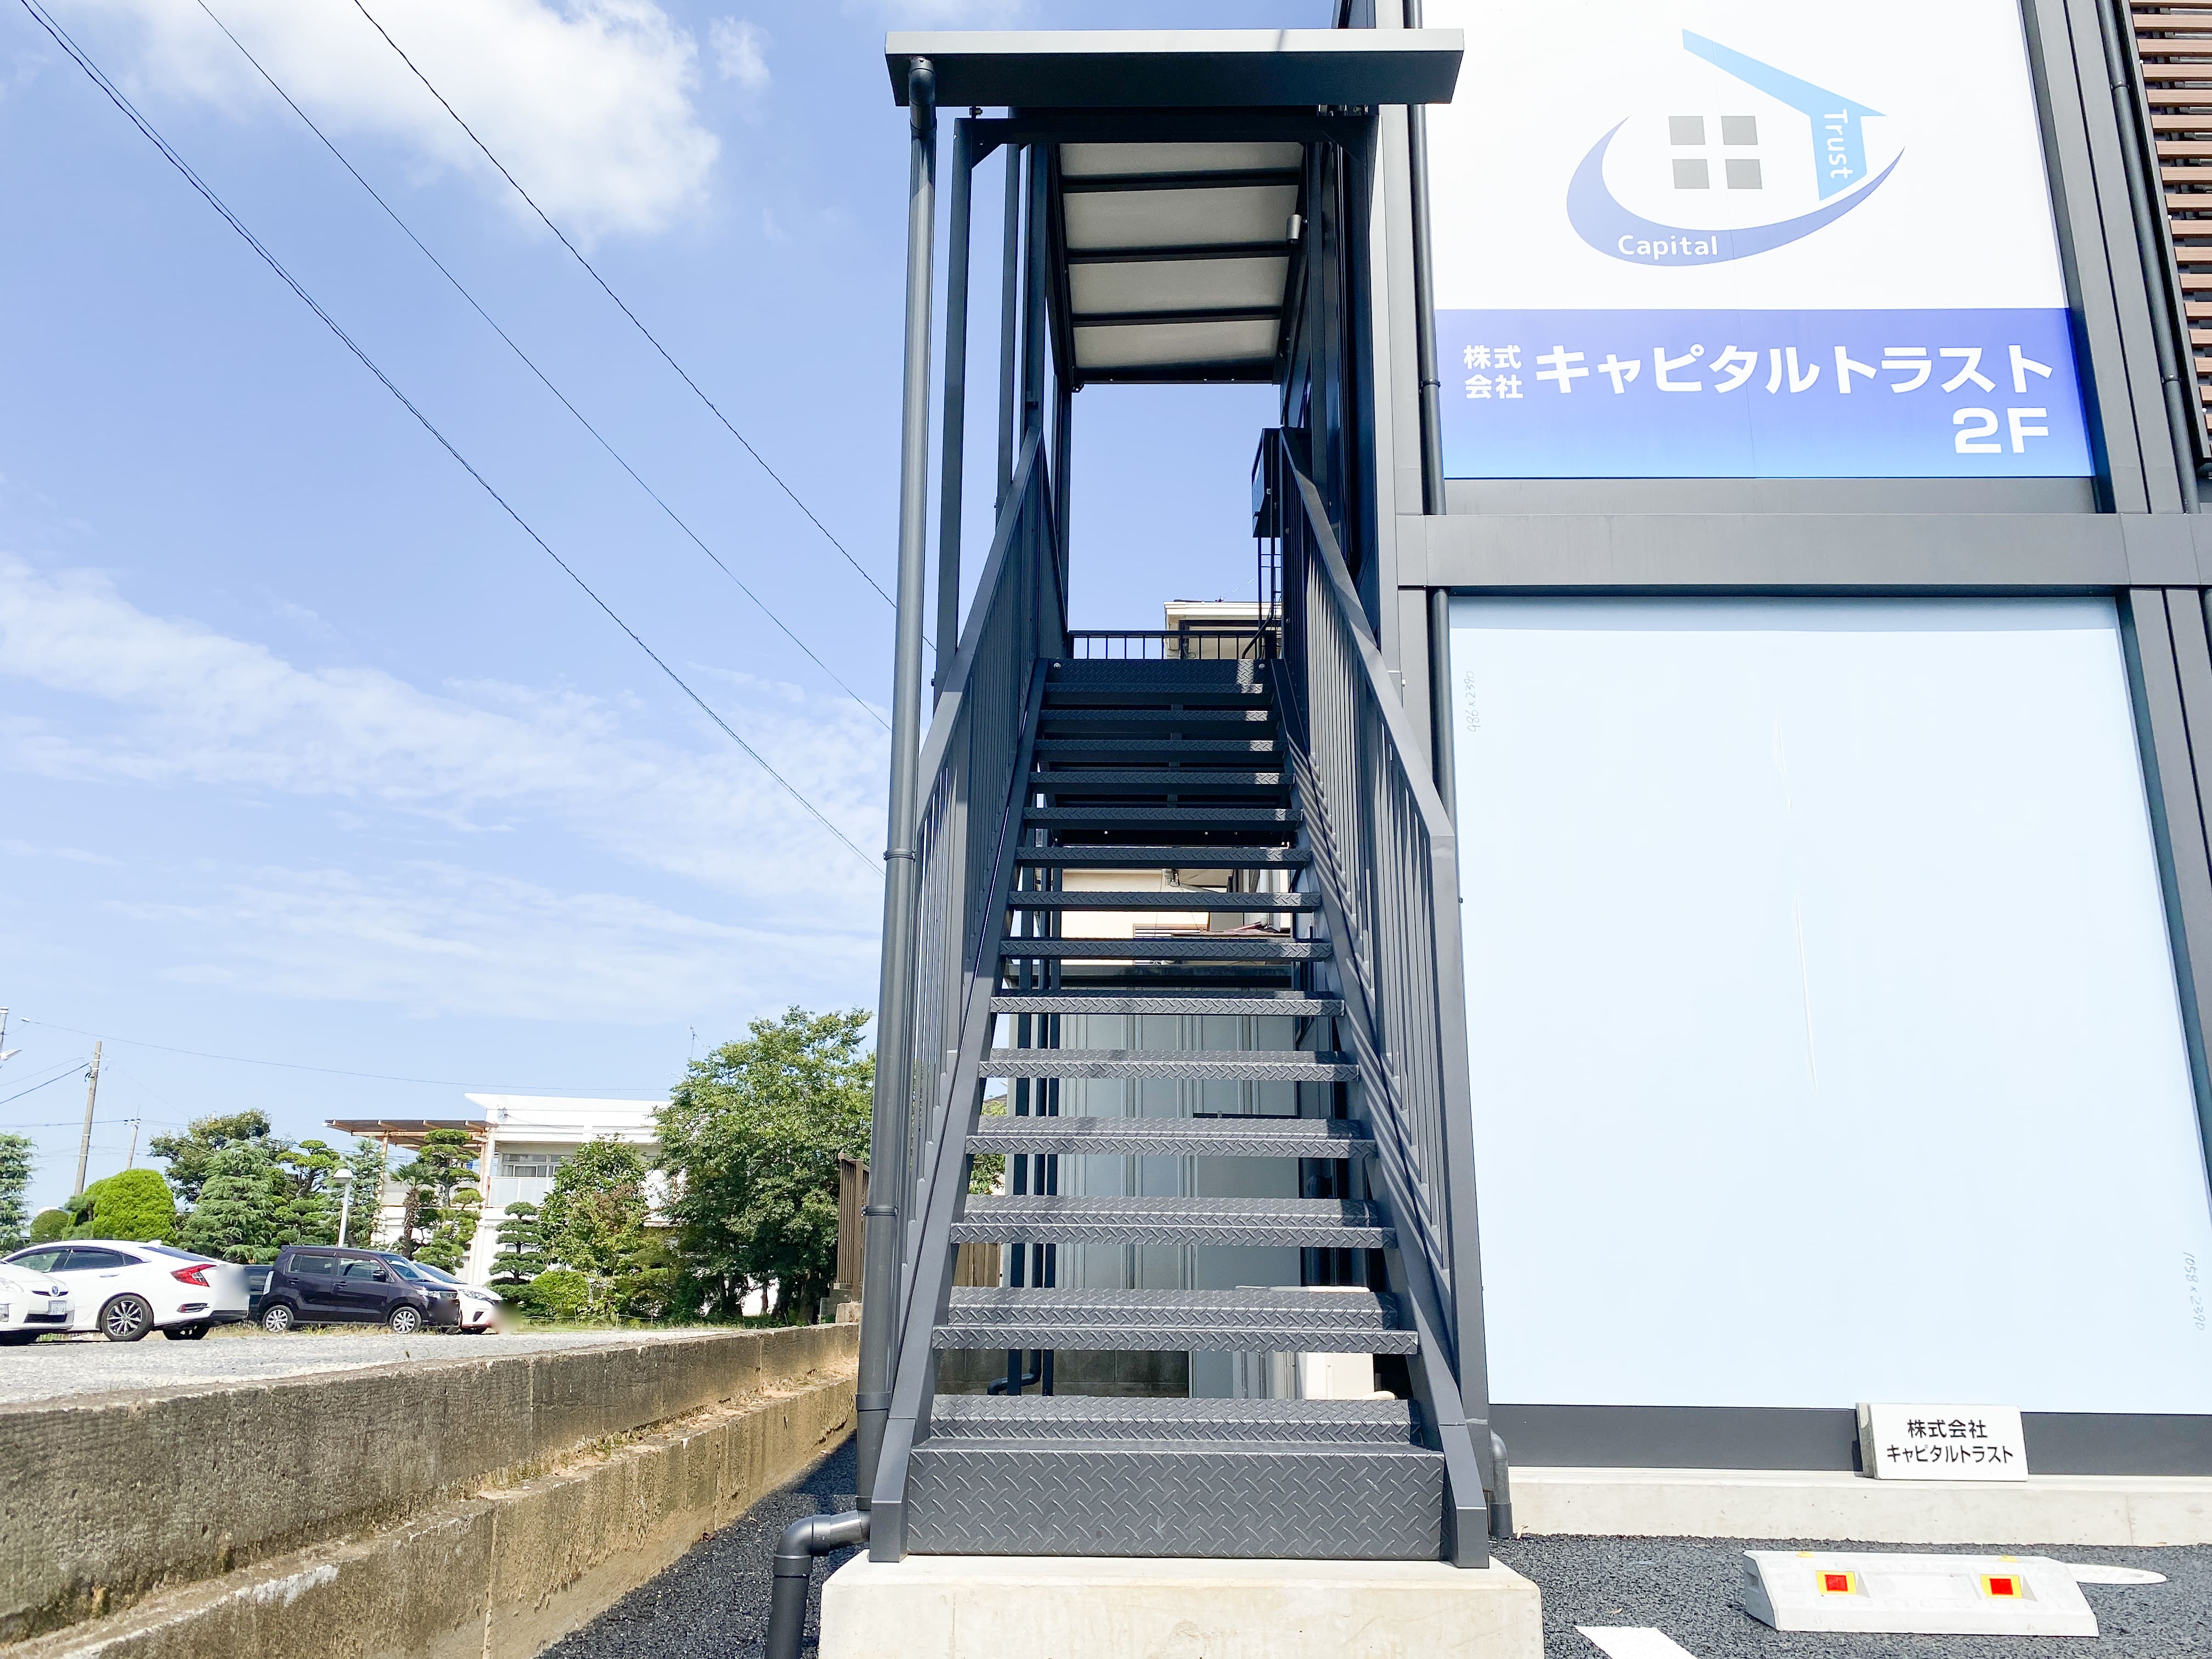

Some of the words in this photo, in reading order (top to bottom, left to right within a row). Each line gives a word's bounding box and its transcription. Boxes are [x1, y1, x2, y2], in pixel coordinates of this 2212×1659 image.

[1823, 109, 1853, 179] Trust
[1618, 235, 1718, 259] Capital
[1463, 345, 1522, 369] 株式
[1535, 344, 2053, 394] キャピタルトラスト
[1464, 374, 1523, 399] 会社
[1953, 407, 2048, 453] 2F
[1907, 1419, 1988, 1438] 株式会社
[1887, 1444, 2013, 1463] キャピタルトラスト
